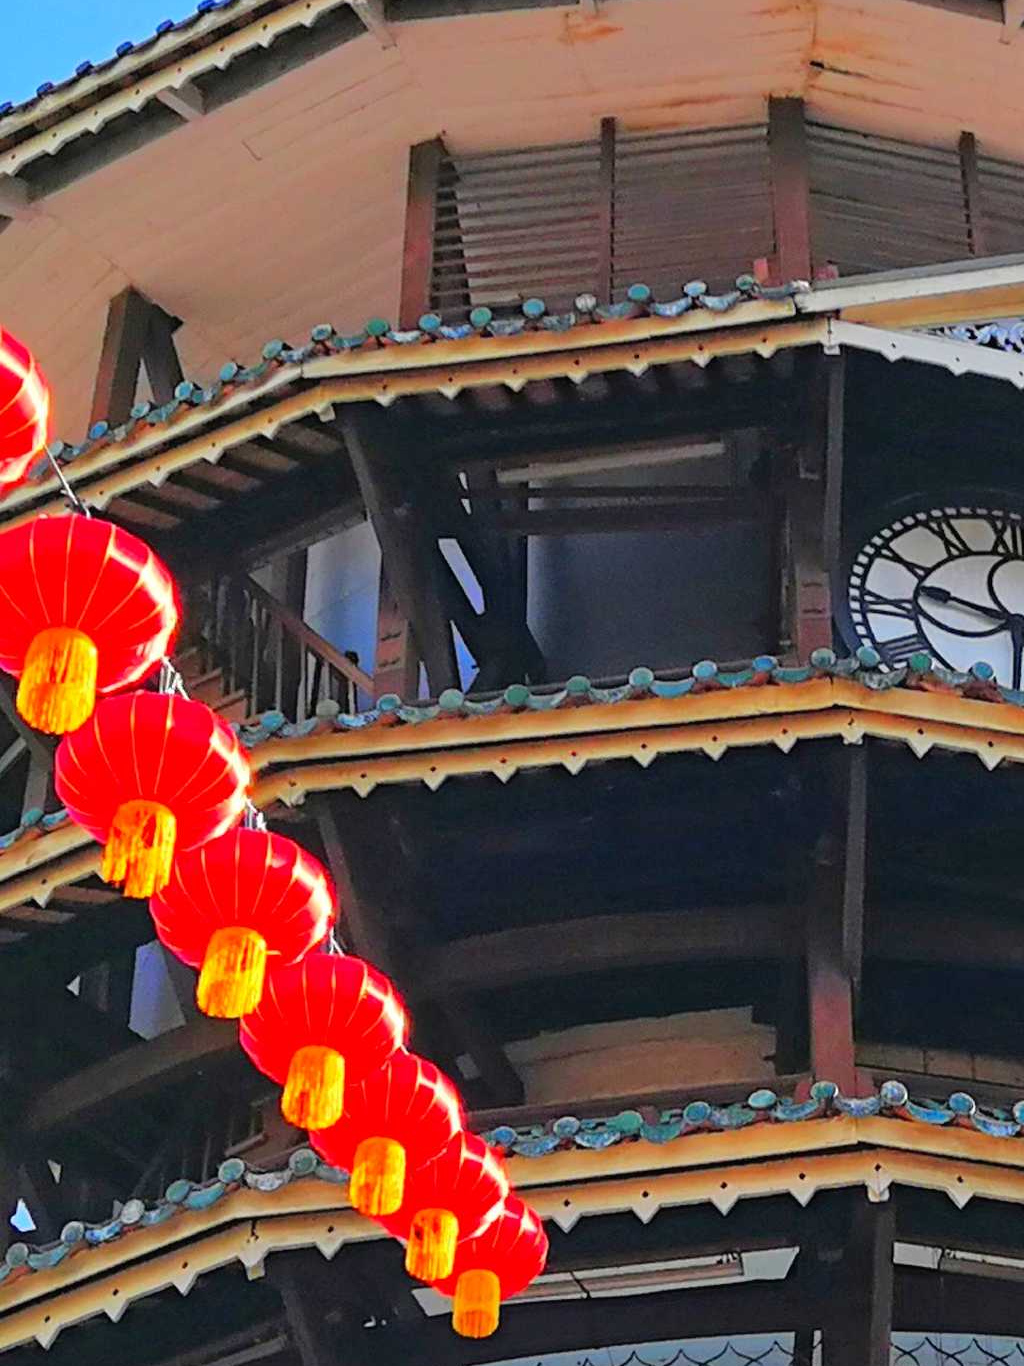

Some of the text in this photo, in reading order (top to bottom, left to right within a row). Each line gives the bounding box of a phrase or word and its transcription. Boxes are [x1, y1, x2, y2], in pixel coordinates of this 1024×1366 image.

[927, 519, 971, 555] XI
[880, 544, 931, 580] X
[864, 591, 915, 619] IX
